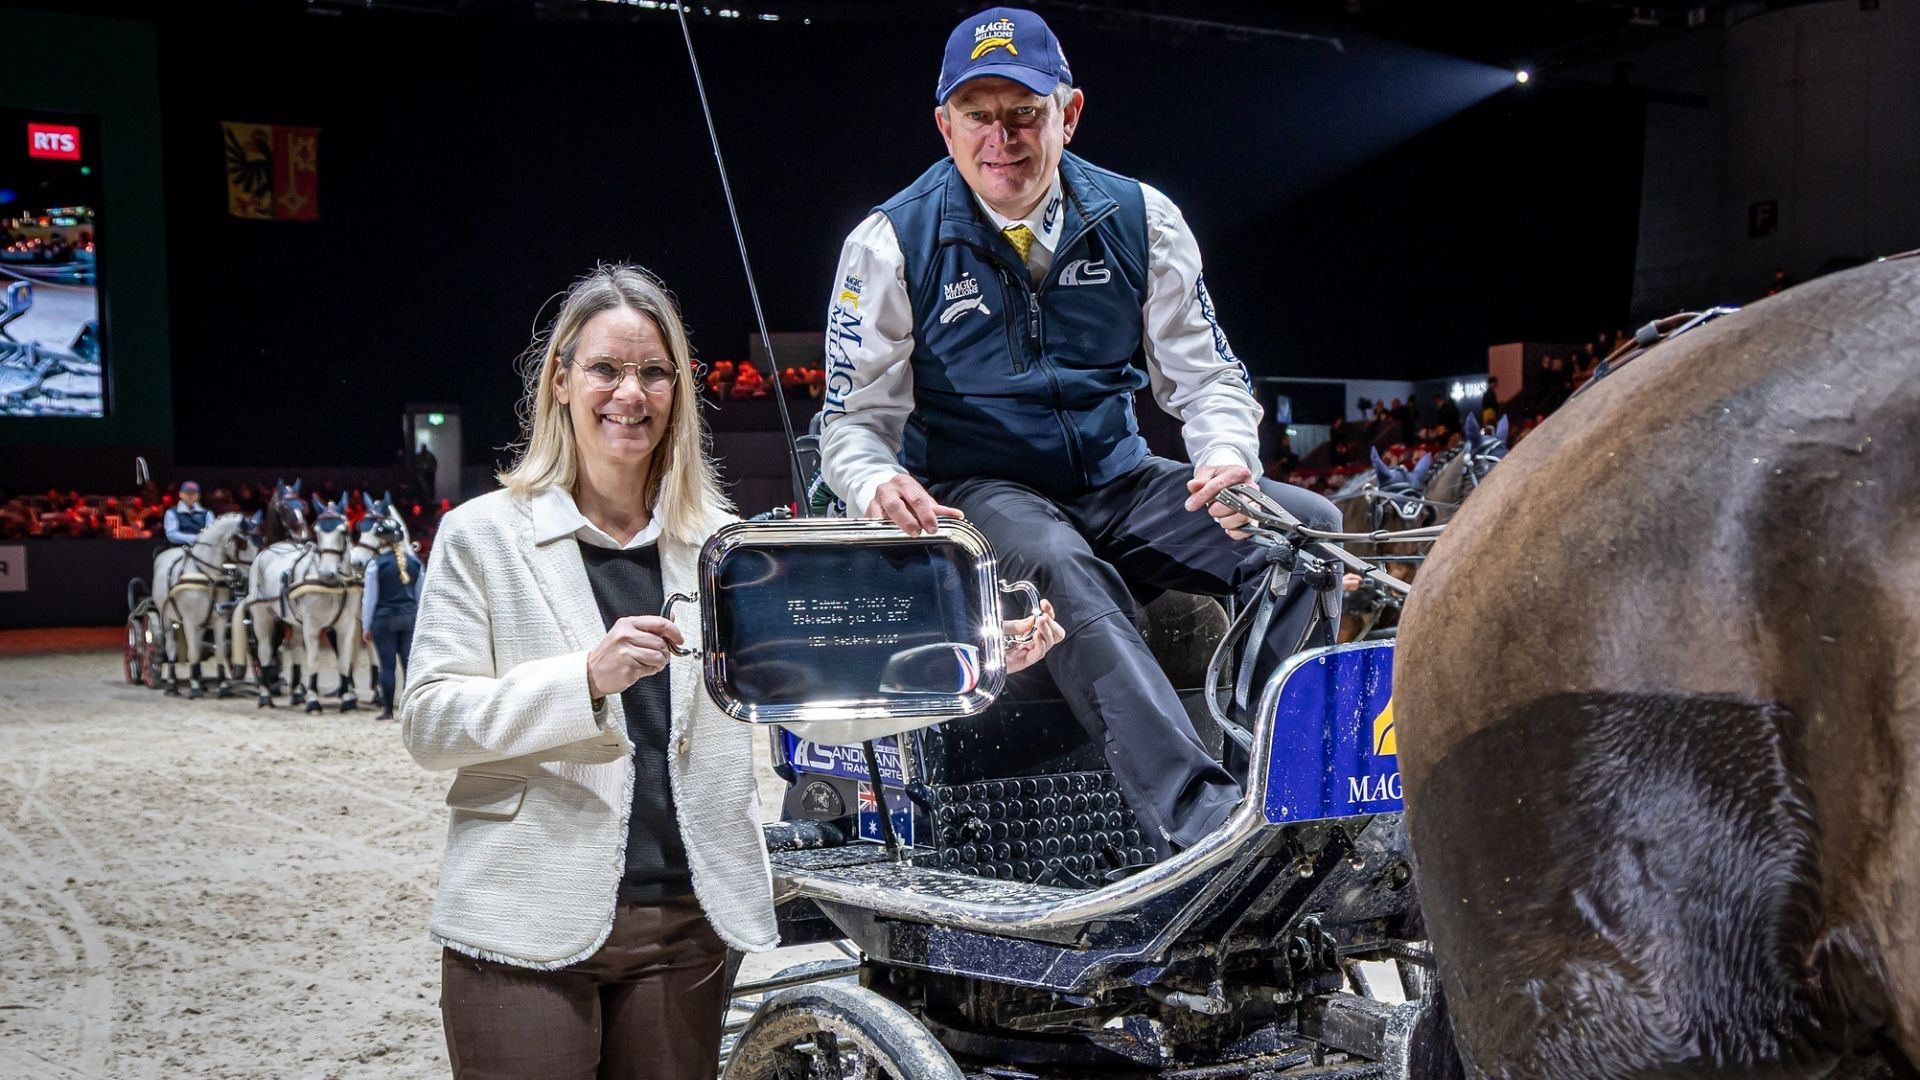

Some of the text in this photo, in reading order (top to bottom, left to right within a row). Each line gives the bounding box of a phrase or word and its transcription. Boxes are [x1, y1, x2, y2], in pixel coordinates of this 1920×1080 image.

[975, 21, 1015, 37] MAGIC
[975, 31, 1013, 43] MILLIONS
[34, 132, 75, 152] RTS
[944, 278, 978, 295] MAGIC
[945, 286, 979, 301] MILLIONS
[823, 307, 863, 428] MAGIC
[842, 761, 903, 780] TRANSORTE
[1347, 772, 1404, 804] MAG
